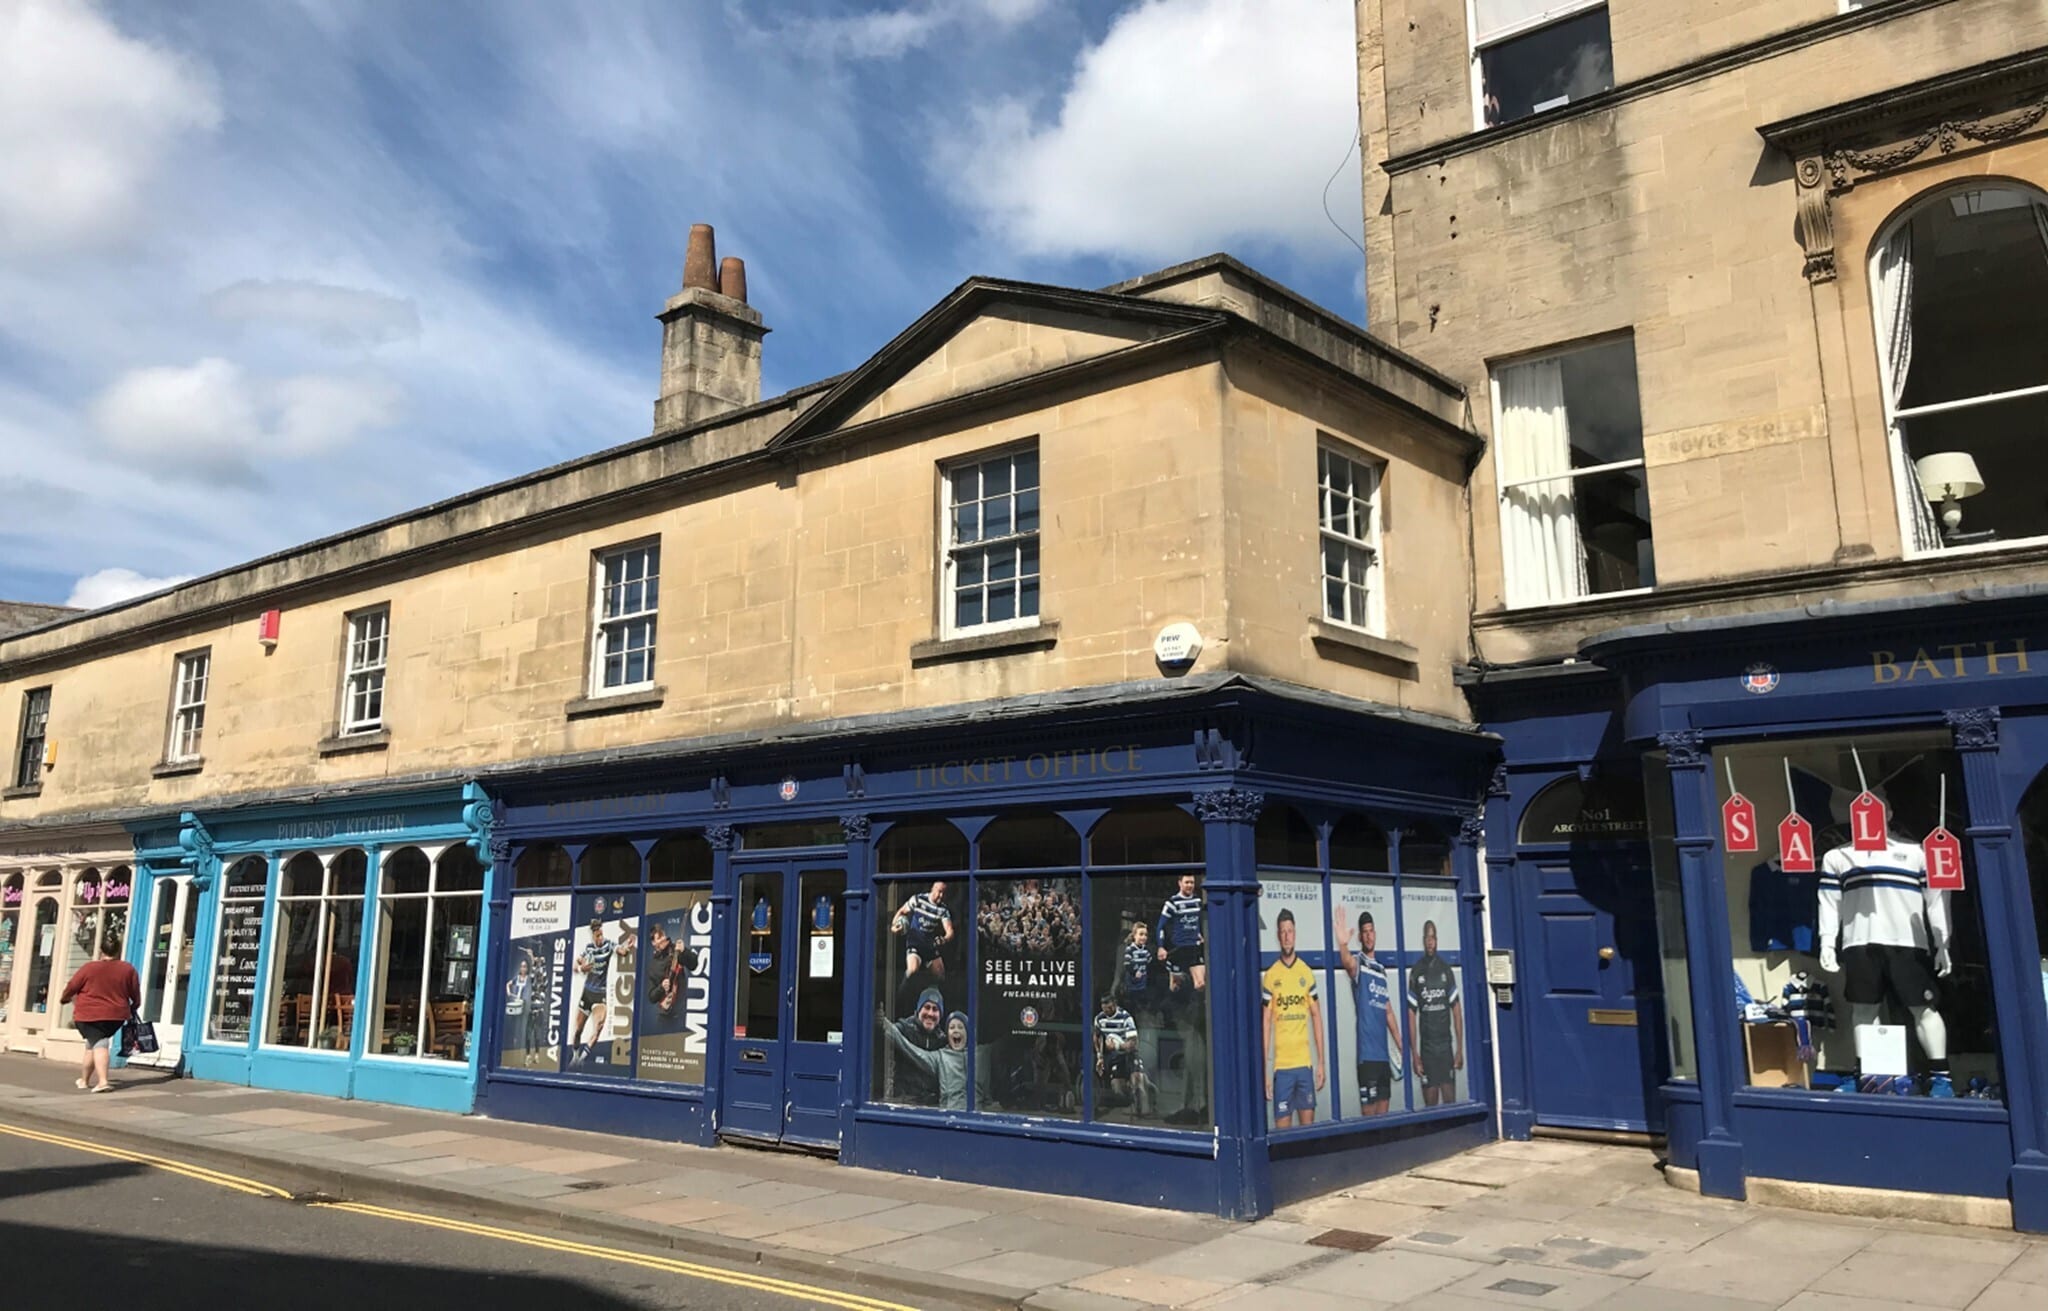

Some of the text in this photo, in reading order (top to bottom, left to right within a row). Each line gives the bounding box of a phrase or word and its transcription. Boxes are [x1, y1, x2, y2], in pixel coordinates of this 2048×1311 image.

[1869, 638, 2033, 685] BATH
[911, 743, 1144, 789] TICKET OFFICE
[278, 814, 405, 840] PULTENEY KITCHEN
[1552, 820, 1644, 834] ARGYLE STREET
[1266, 883, 1318, 893] GET YOURSELF
[1348, 887, 1377, 895] OFFICIAL
[1266, 892, 1318, 901] MATCH READY
[1342, 895, 1384, 904] PLAYING KIT
[526, 900, 557, 912] CLASH
[985, 960, 1075, 973] SEE IT LIVE
[685, 901, 713, 1054] MUSIC
[985, 973, 1075, 987] FEEL ALIVE
[546, 937, 566, 1062] ACTIVITIES
[1002, 990, 1057, 999] #WEAREBATH
[1420, 986, 1446, 1001] dyson
[1276, 994, 1305, 1010] dyson
